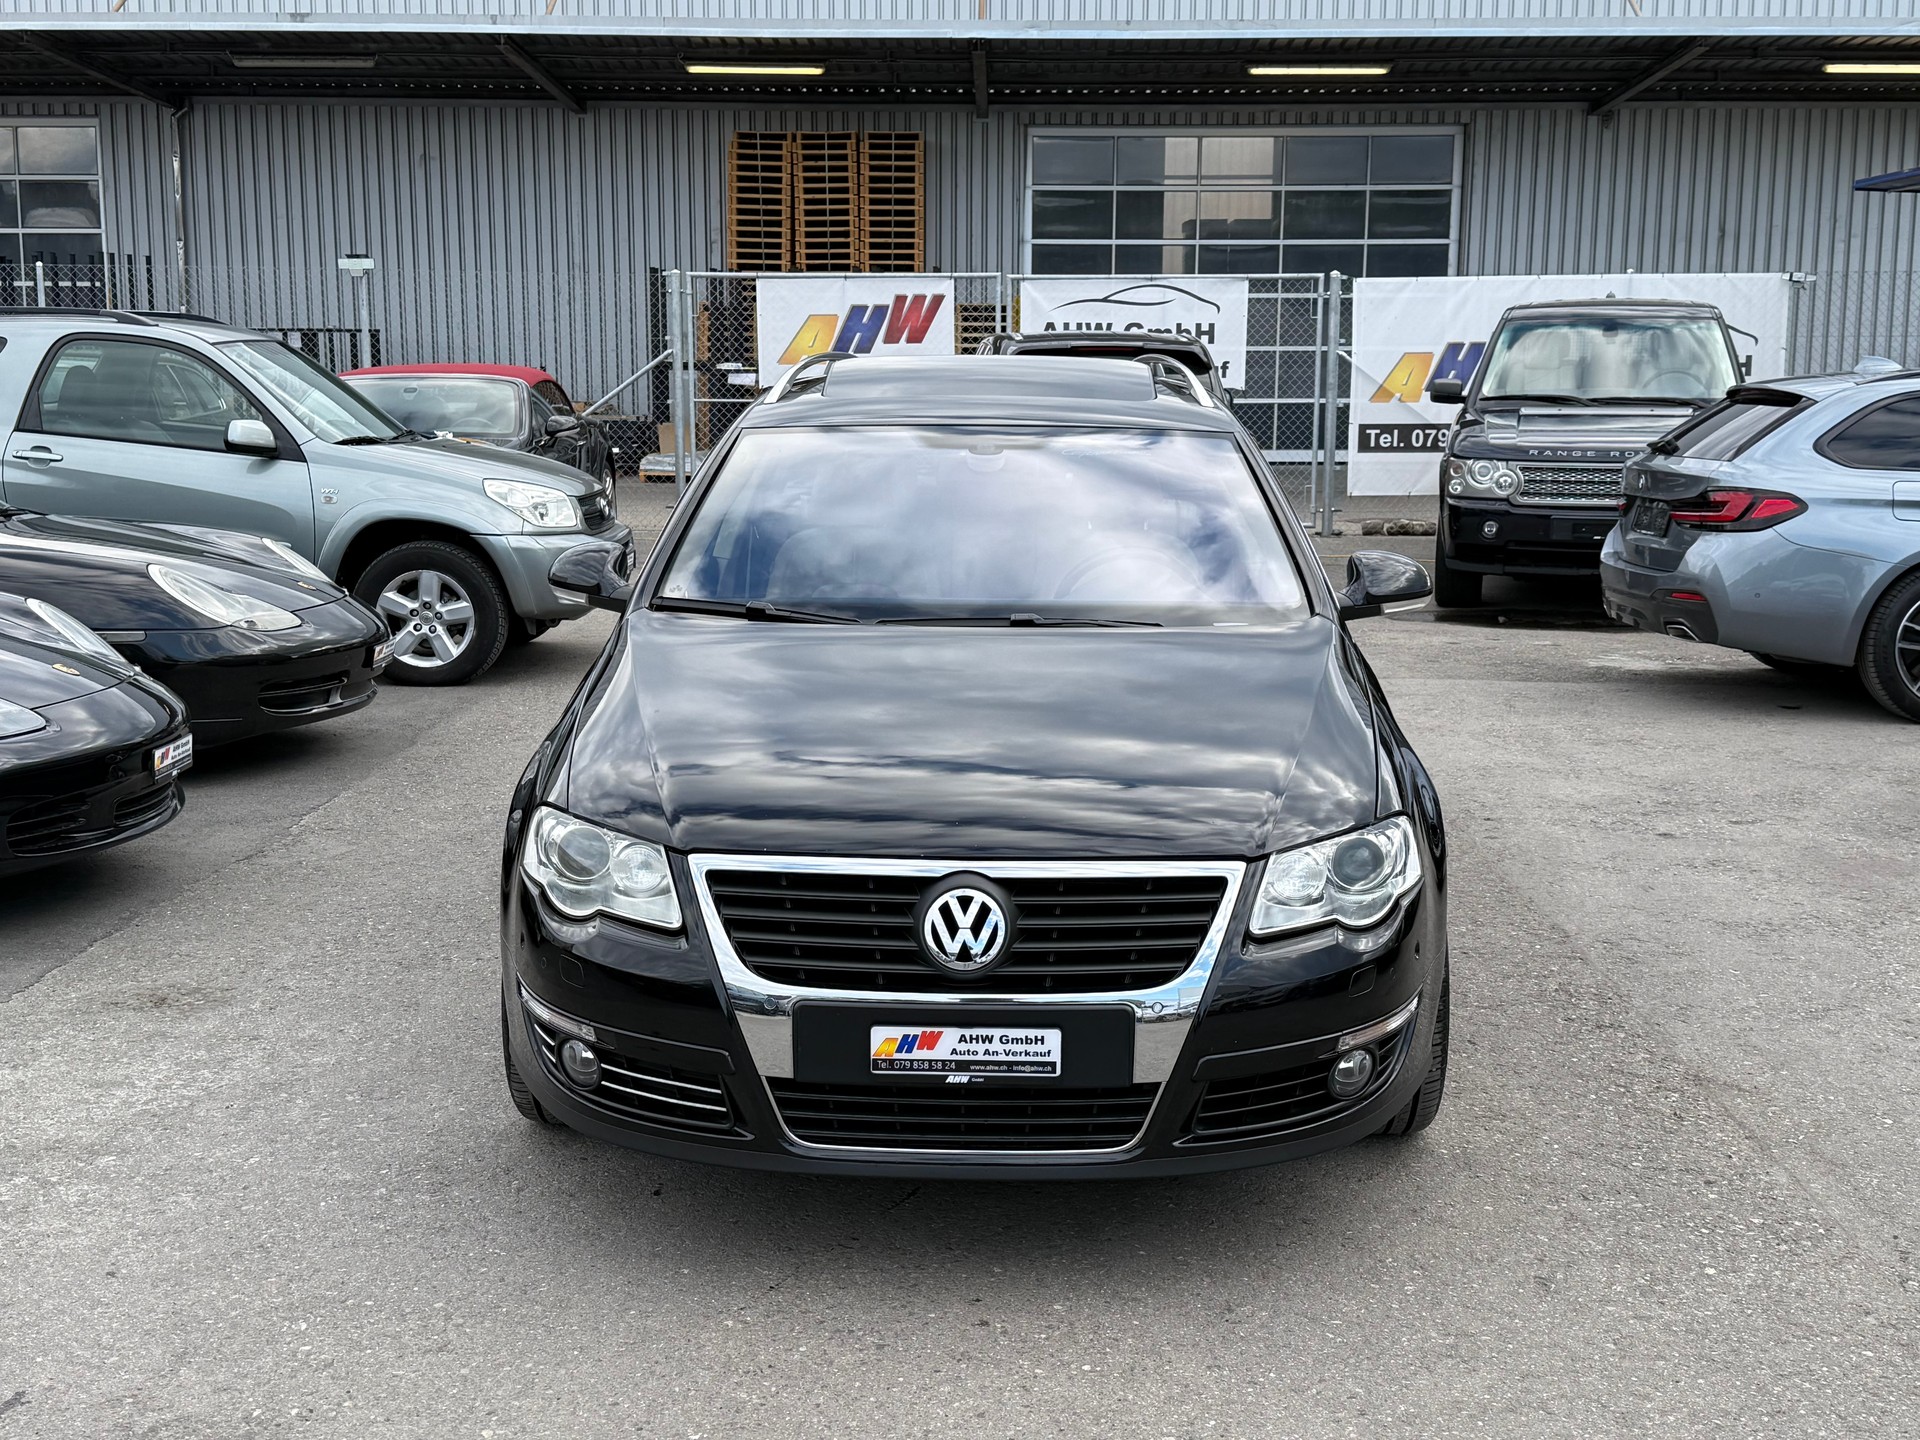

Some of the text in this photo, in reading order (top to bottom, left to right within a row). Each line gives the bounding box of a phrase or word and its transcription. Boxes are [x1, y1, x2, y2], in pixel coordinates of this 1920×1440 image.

[777, 293, 946, 365] AHW
[1365, 429, 1450, 447] Tel. 079
[1528, 449, 1597, 457] RANGE
[872, 1031, 944, 1057] AHW
[957, 1034, 1045, 1046] AHW GmbH
[950, 1048, 1052, 1058] Auto An-Verkauf
[877, 1060, 956, 1070] Tel. 079 858 58 24
[945, 1075, 970, 1084] AHW
